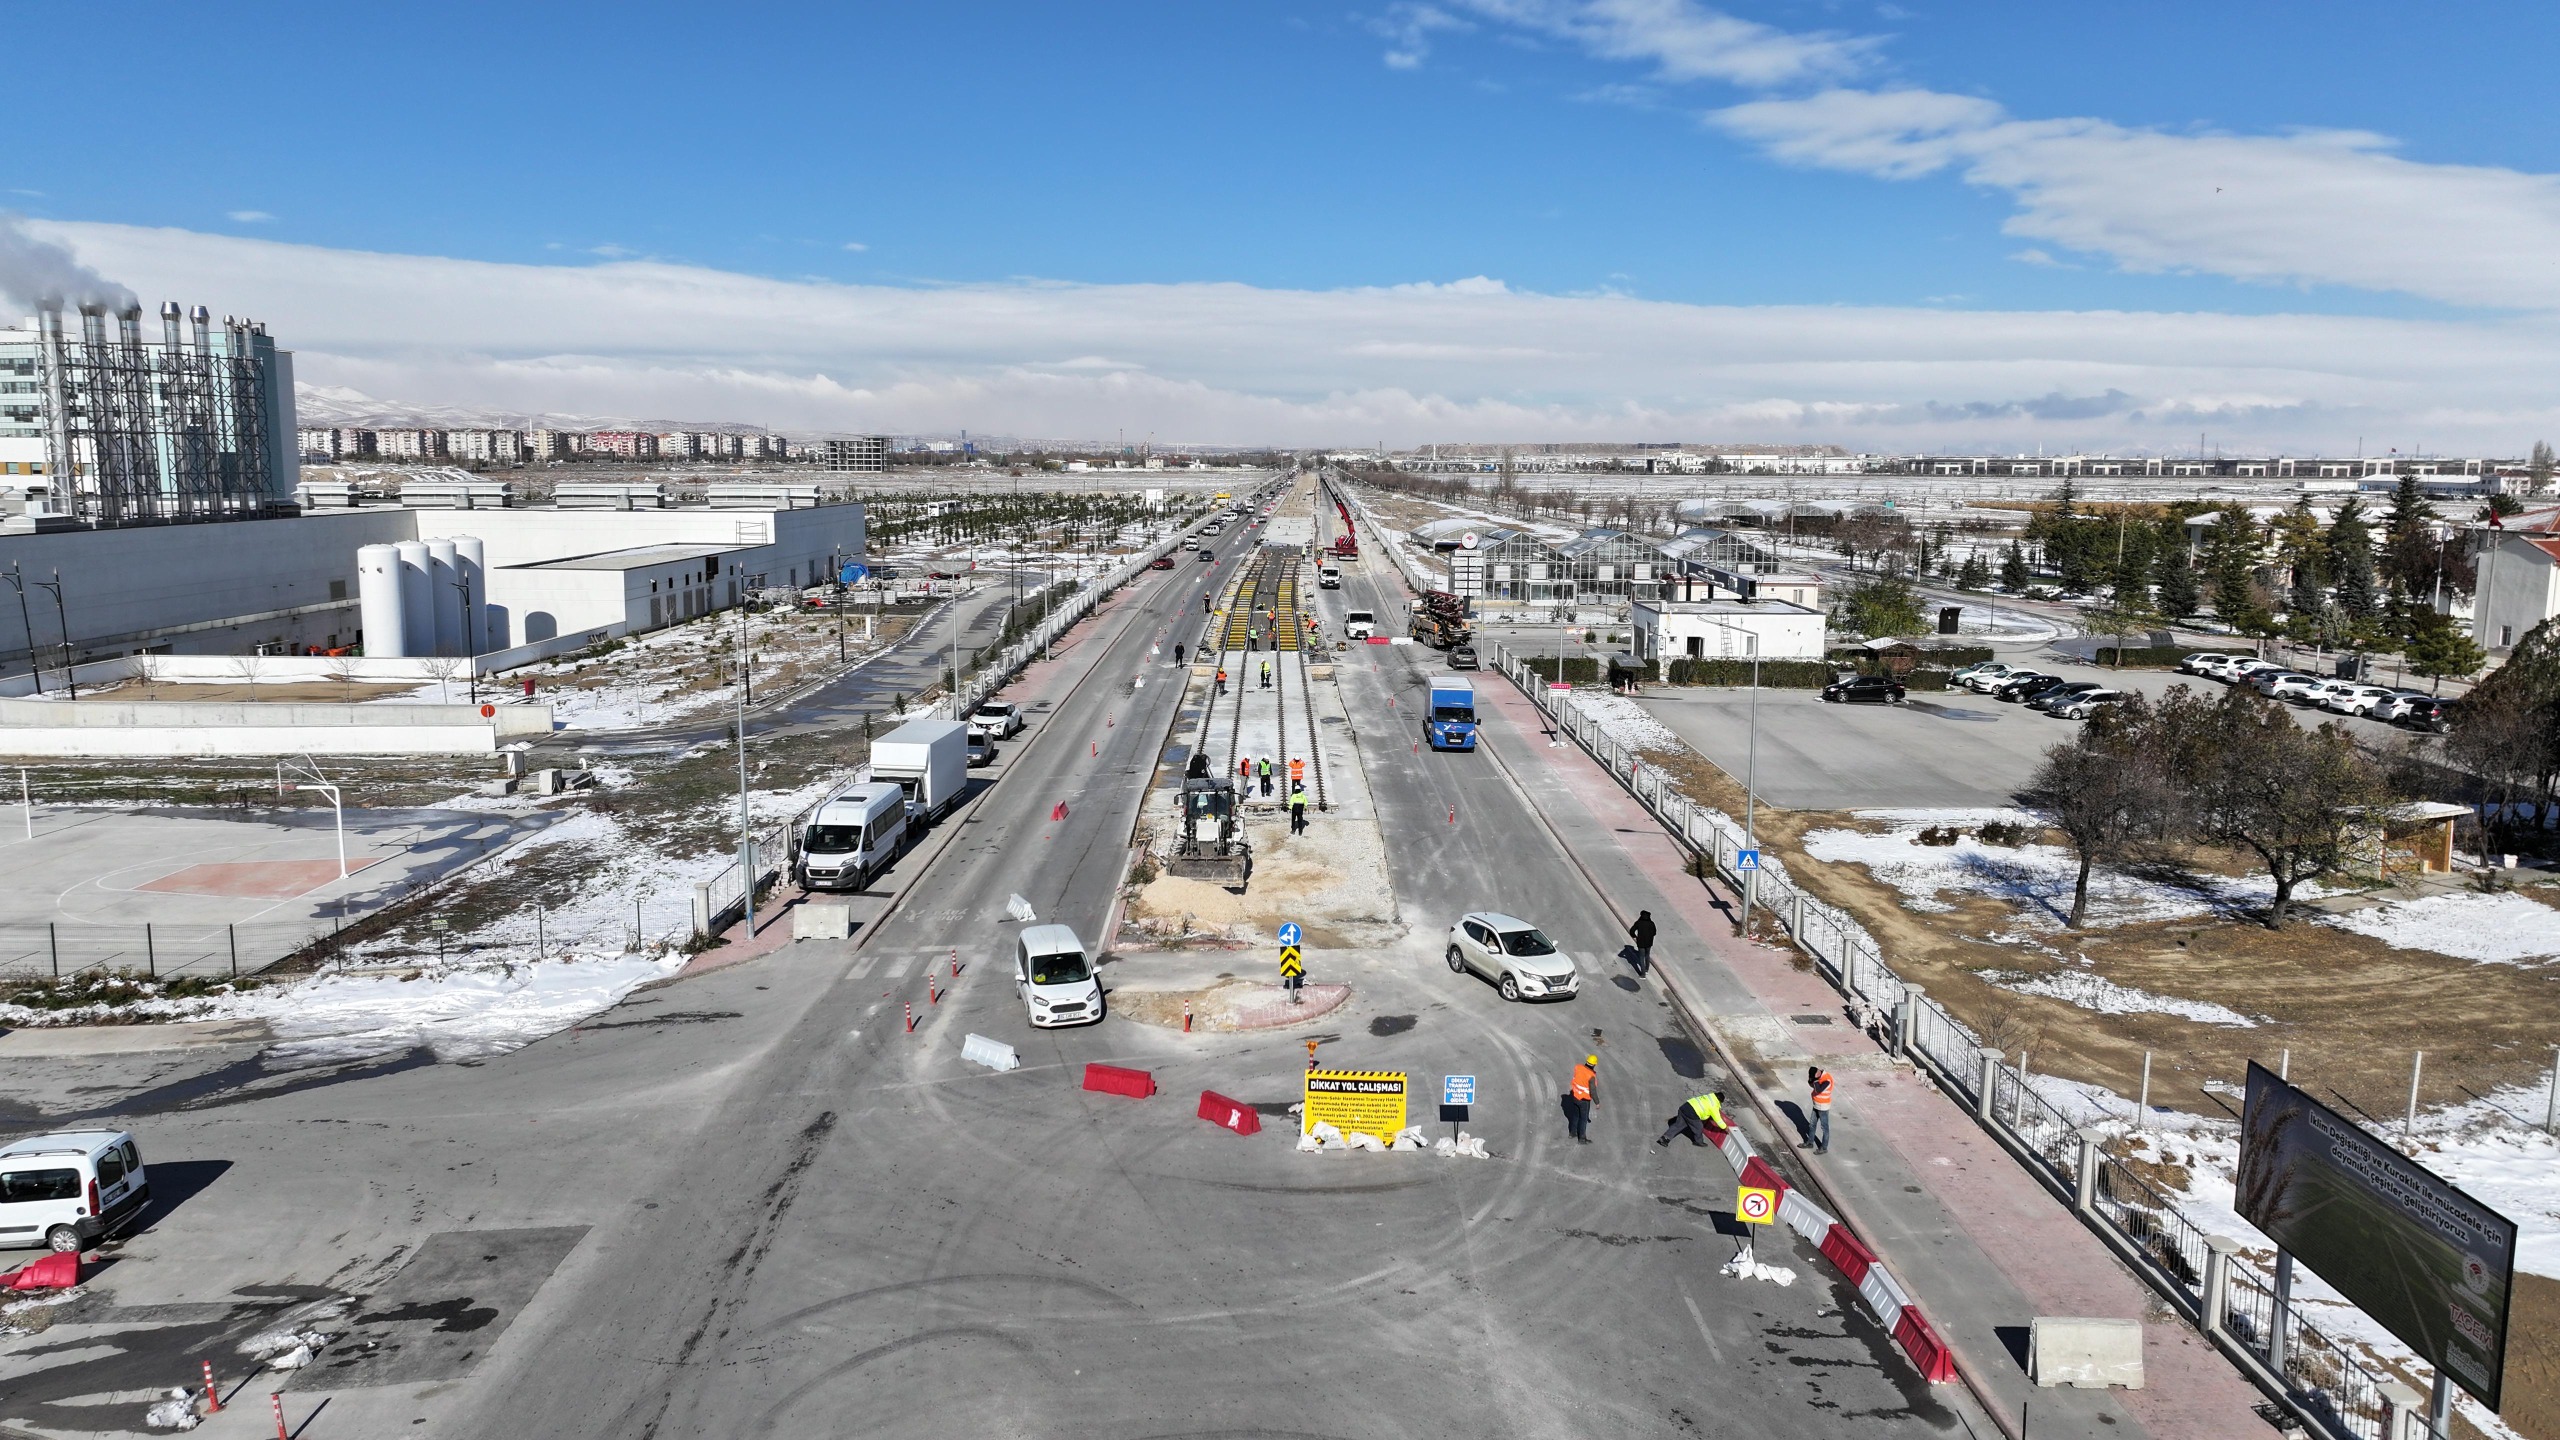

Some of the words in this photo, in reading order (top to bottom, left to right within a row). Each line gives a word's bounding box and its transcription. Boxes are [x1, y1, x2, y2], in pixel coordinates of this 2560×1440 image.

[1310, 1079, 1340, 1090] DİKKAT
[1341, 1082, 1357, 1090] YOL
[1358, 1082, 1402, 1094] ÇALIŞMASI
[2309, 1110, 2329, 1134] İklim
[2329, 1126, 2371, 1163] Değişikliği
[2371, 1155, 2383, 1168] ve
[2384, 1161, 2420, 1193] Kuraklık
[2422, 1185, 2434, 1201] ile
[2435, 1197, 2482, 1232] mücadele
[2484, 1224, 2502, 1245] için
[2331, 1146, 2369, 1177] dayanıklı
[2370, 1172, 2403, 1198] çeşitler
[2404, 1194, 2469, 1242] geliştiriyoruz.
